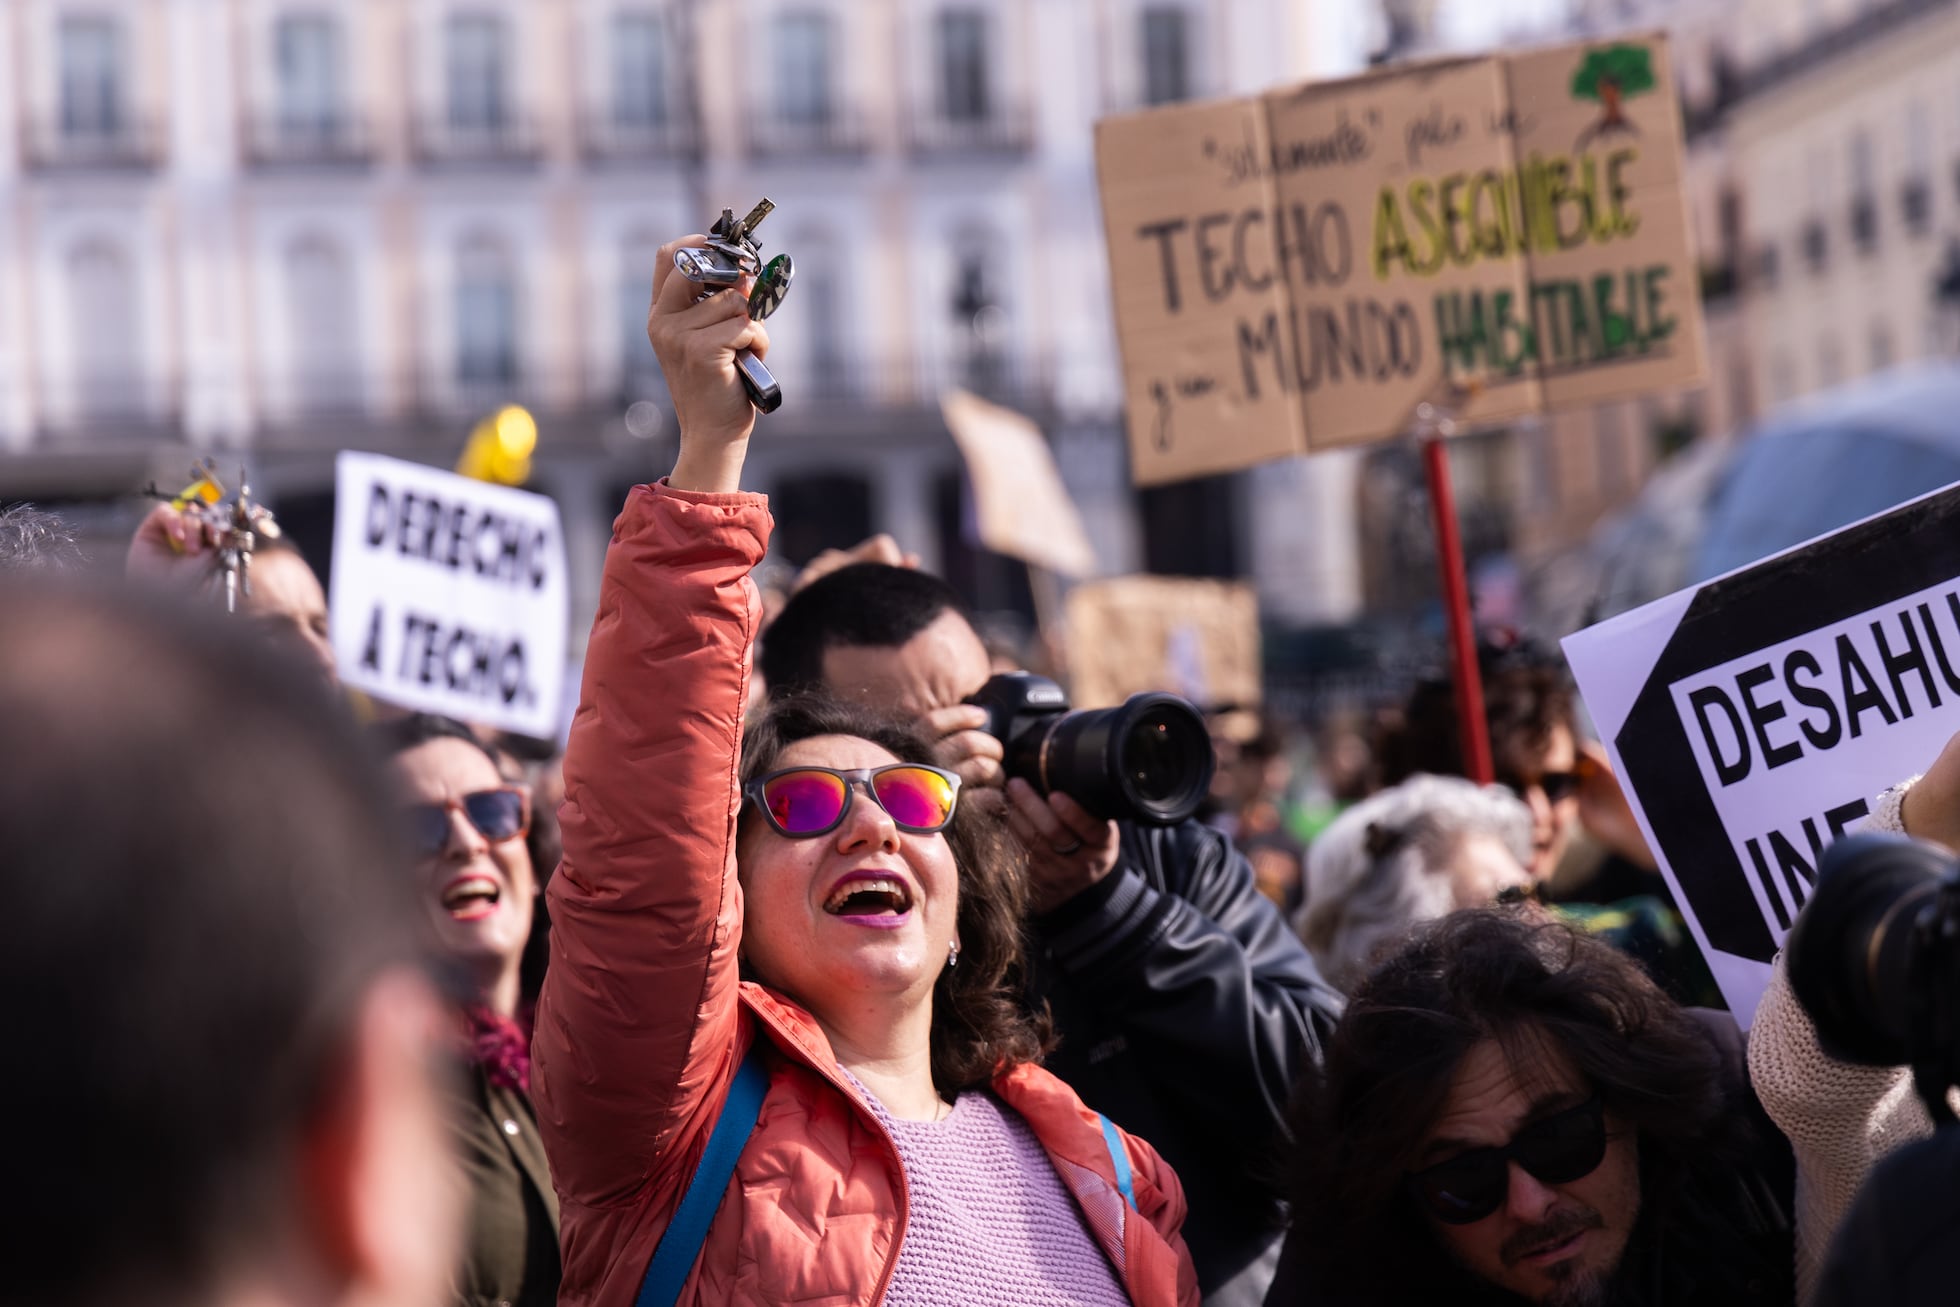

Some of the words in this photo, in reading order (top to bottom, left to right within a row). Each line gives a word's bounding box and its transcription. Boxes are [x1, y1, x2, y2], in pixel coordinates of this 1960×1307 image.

[1136, 200, 1353, 314] TECHO
[1370, 150, 1642, 282] ASEQUIBLE
[1148, 377, 1175, 453] y
[1236, 301, 1424, 401] MUNDO
[1433, 266, 1678, 374] HABITABLE
[366, 480, 547, 589] DERECHO
[360, 604, 382, 672] A
[399, 611, 538, 707] TECHO.
[1689, 592, 1960, 787] DESAHU
